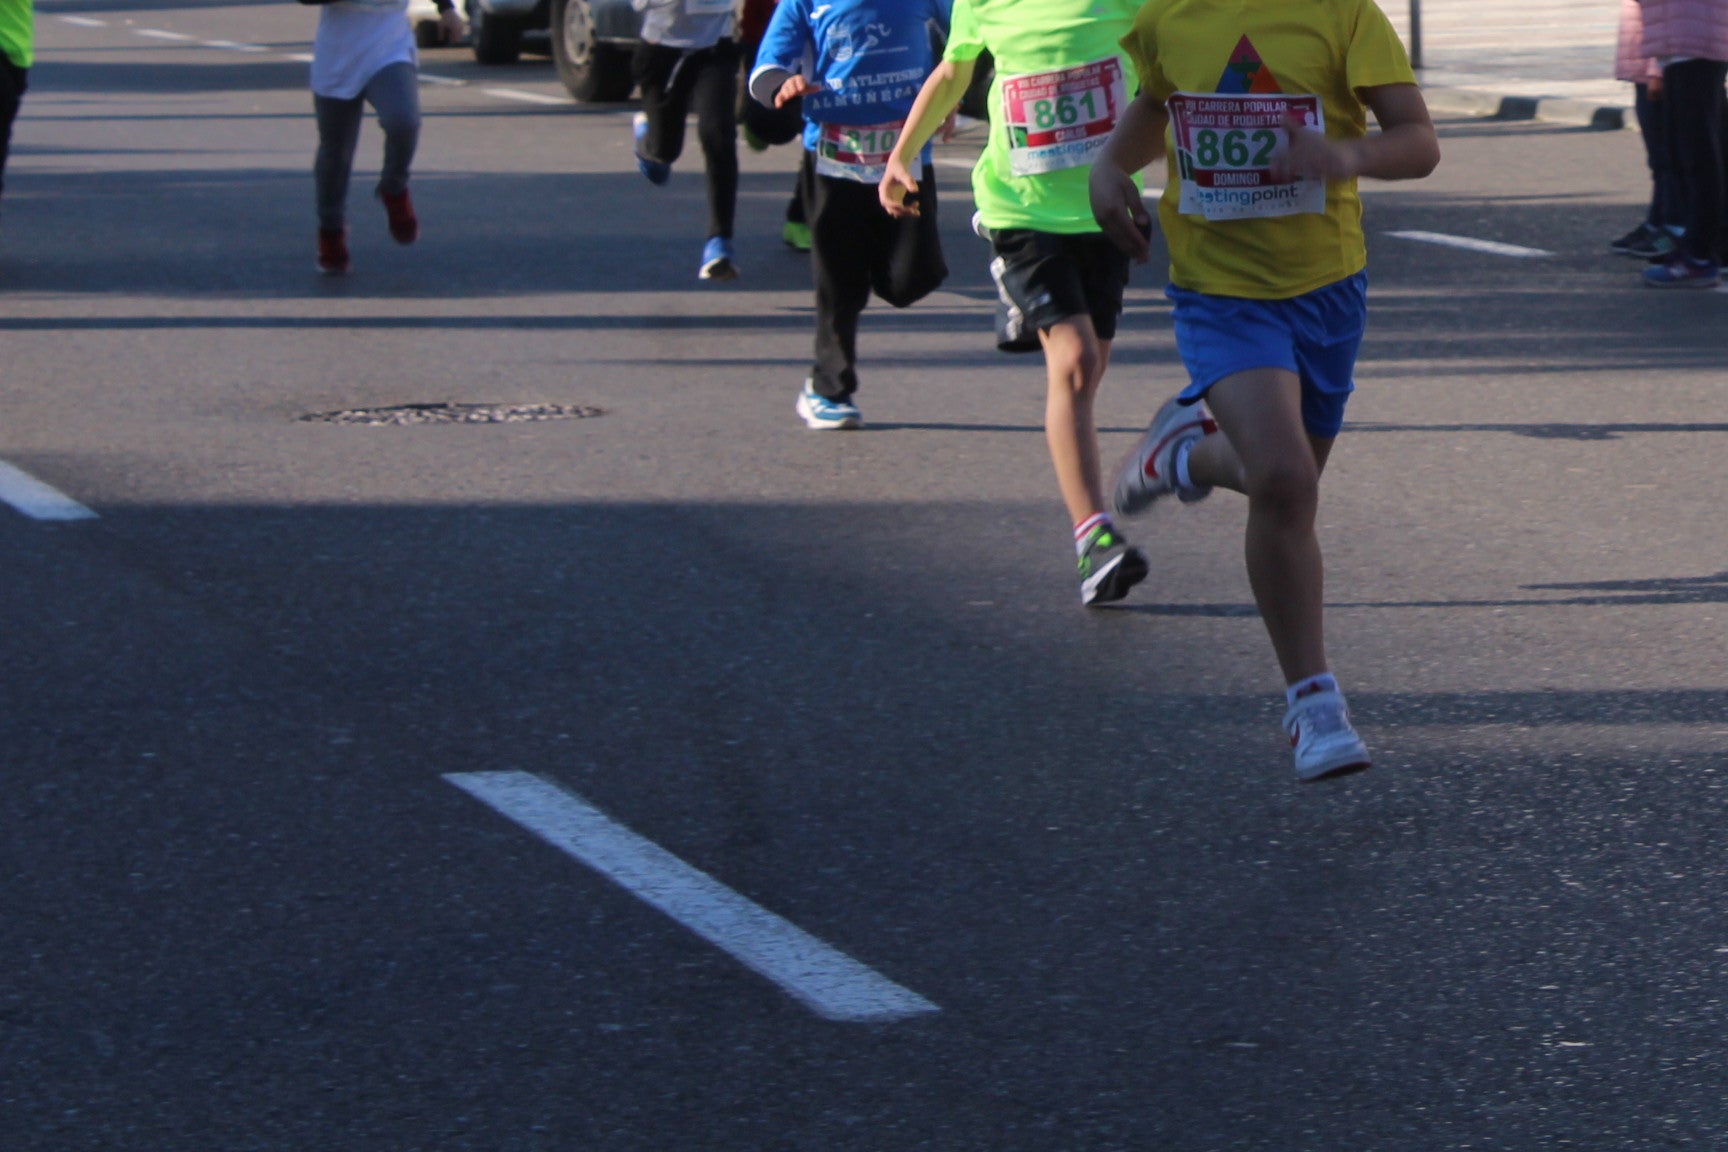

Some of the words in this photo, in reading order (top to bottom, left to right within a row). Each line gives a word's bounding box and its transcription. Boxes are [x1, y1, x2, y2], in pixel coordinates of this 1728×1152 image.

[1034, 90, 1096, 128] 861
[1199, 101, 1241, 113] CARRERA
[1243, 101, 1288, 112] POPULAR
[1217, 115, 1231, 126] DE
[846, 129, 895, 153] 810
[1196, 129, 1277, 167] 862
[1213, 173, 1260, 186] DOMINGO
